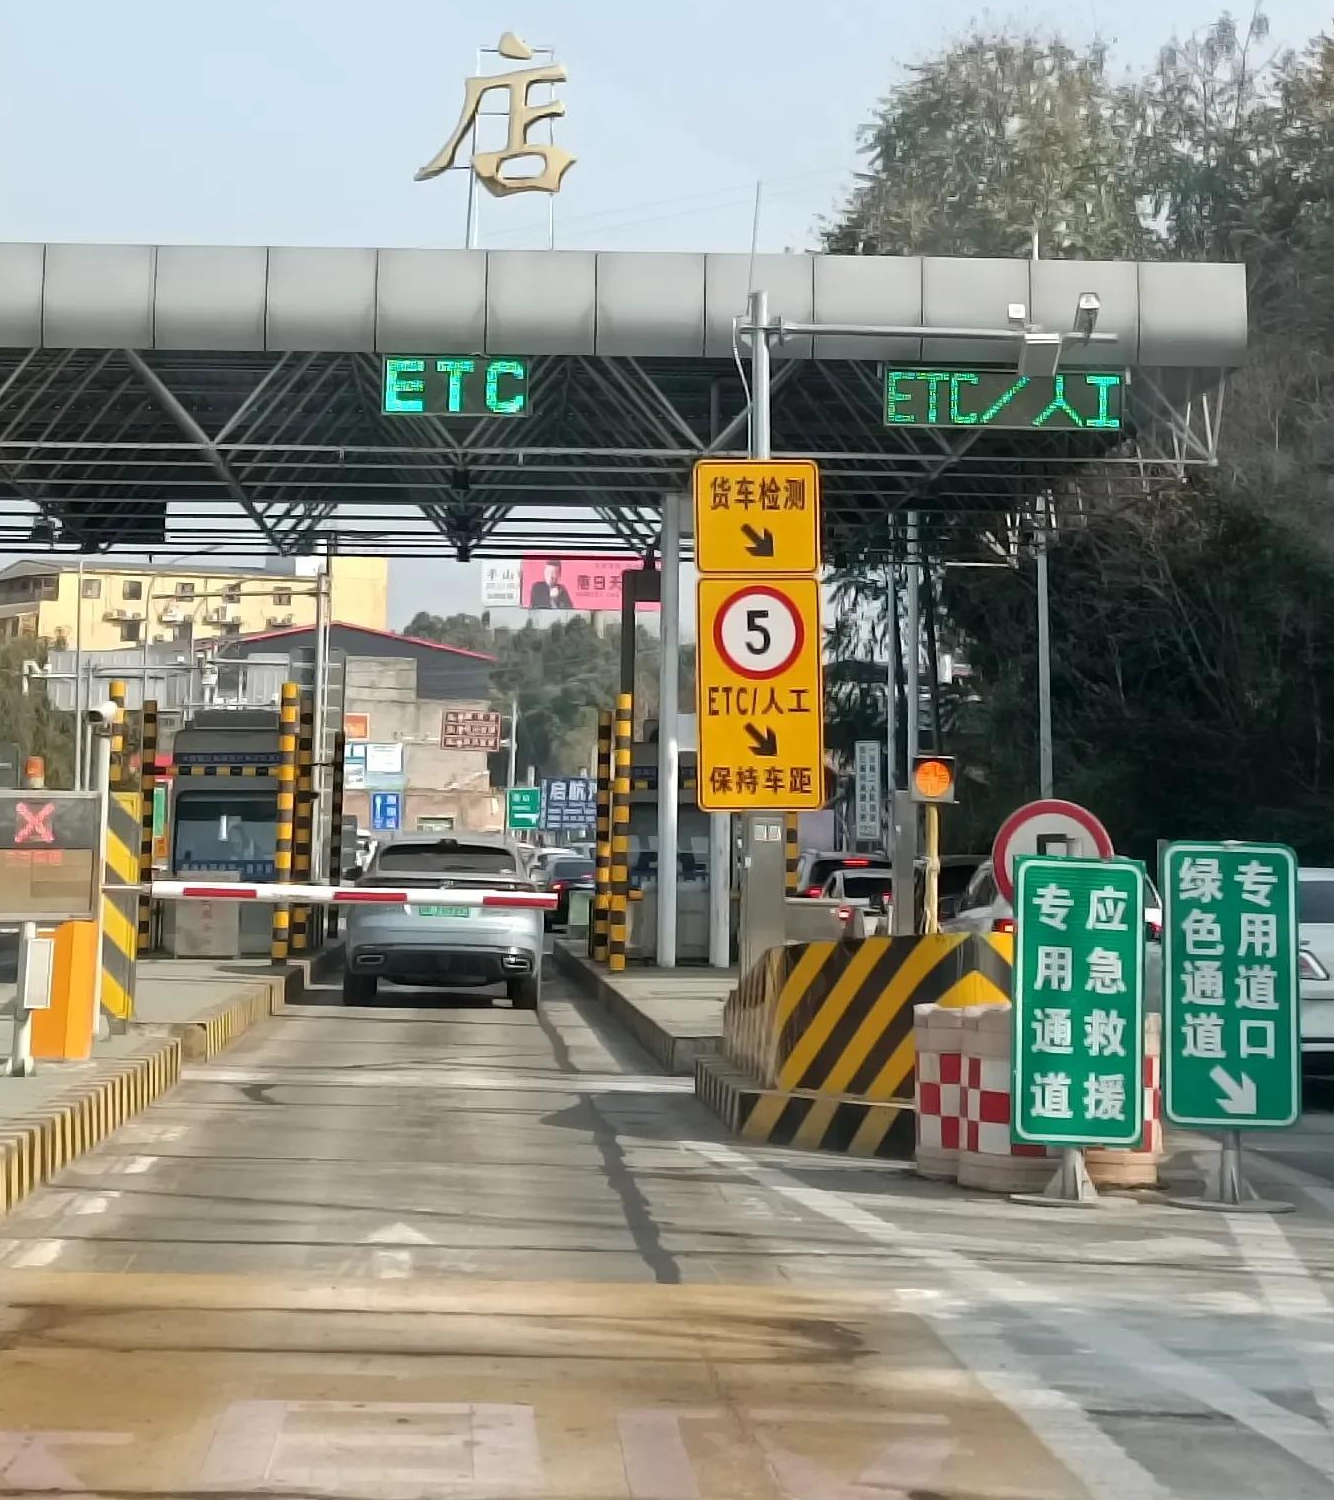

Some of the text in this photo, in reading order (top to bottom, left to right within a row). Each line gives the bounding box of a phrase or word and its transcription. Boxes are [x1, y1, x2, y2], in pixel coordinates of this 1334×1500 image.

[385, 359, 525, 414] ETC
[709, 476, 806, 512] 货车检测
[744, 609, 771, 656] 5
[708, 686, 811, 717] ETC/人工
[709, 765, 813, 796] 保持车距
[1178, 857, 1227, 1060] 绿色通道
[1233, 859, 1279, 1060] 专用道口
[1029, 883, 1075, 1120] 专用通道
[1082, 885, 1129, 1122] 应急救援
